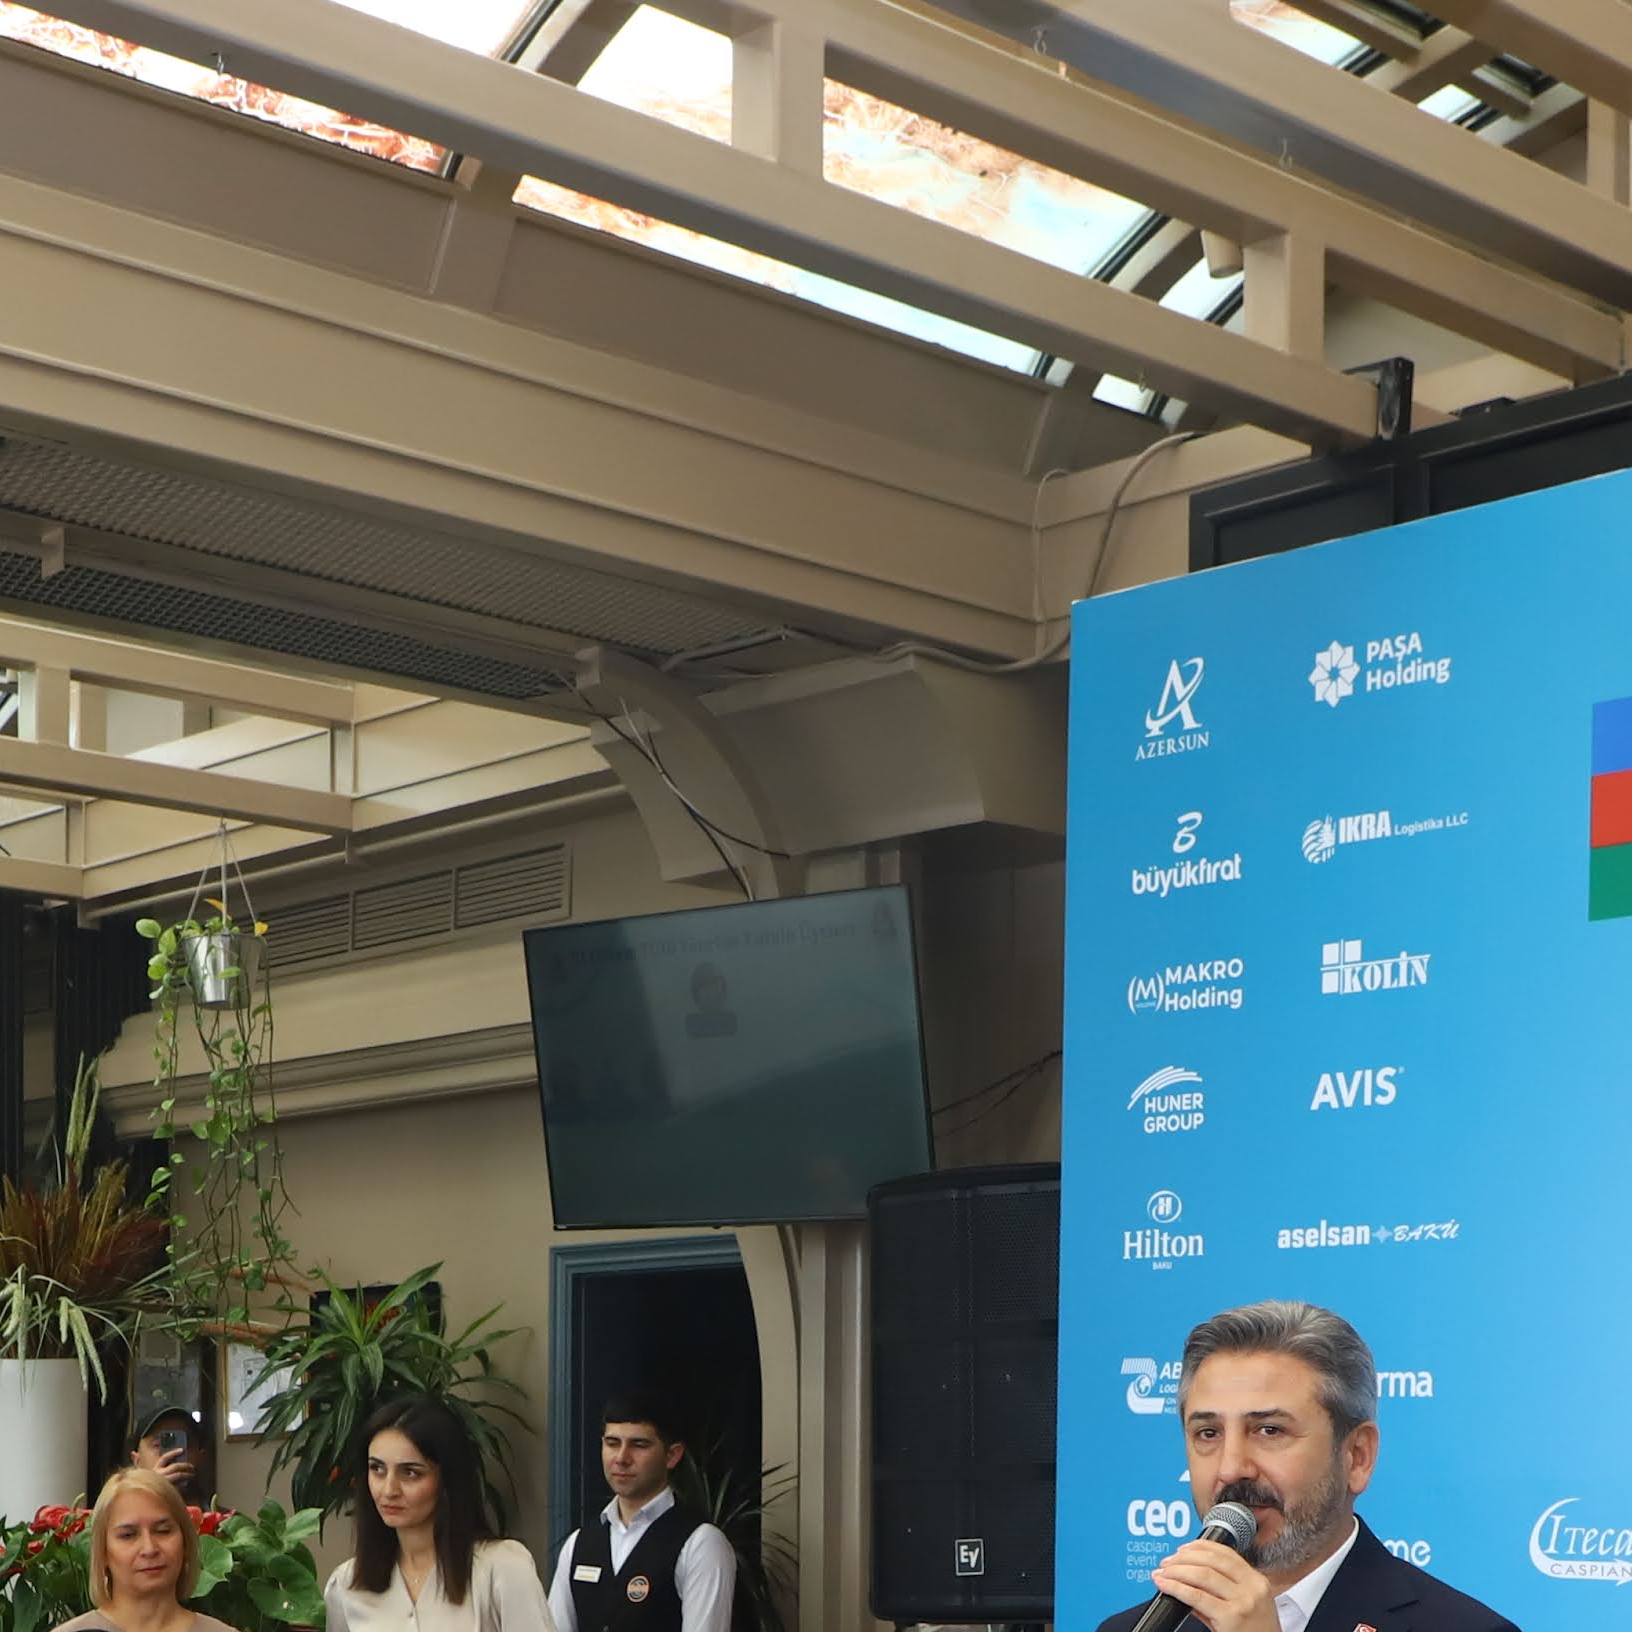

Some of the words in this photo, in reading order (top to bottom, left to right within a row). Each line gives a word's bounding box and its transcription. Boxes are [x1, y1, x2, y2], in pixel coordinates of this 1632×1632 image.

[1366, 632, 1423, 663] PAŞA
[1366, 657, 1451, 692] Holding
[1135, 732, 1209, 761] AZERSUN
[1339, 810, 1392, 844] IKRA
[1394, 817, 1443, 836] Logistika
[1446, 812, 1469, 827] LLC
[1165, 958, 1243, 986] MAKRO
[1165, 987, 1243, 1012] Holding
[1310, 1066, 1397, 1111] AVIS
[1144, 1092, 1204, 1114] HUNER
[1144, 1114, 1204, 1134] GROUP
[1123, 1228, 1204, 1260] Hilton
[1277, 1219, 1371, 1249] aselsan
[1376, 1371, 1434, 1398] rma
[1127, 1500, 1191, 1538] ceo
[1127, 1541, 1170, 1554] caspian
[1127, 1554, 1157, 1567] event
[1127, 1568, 1151, 1584] orga
